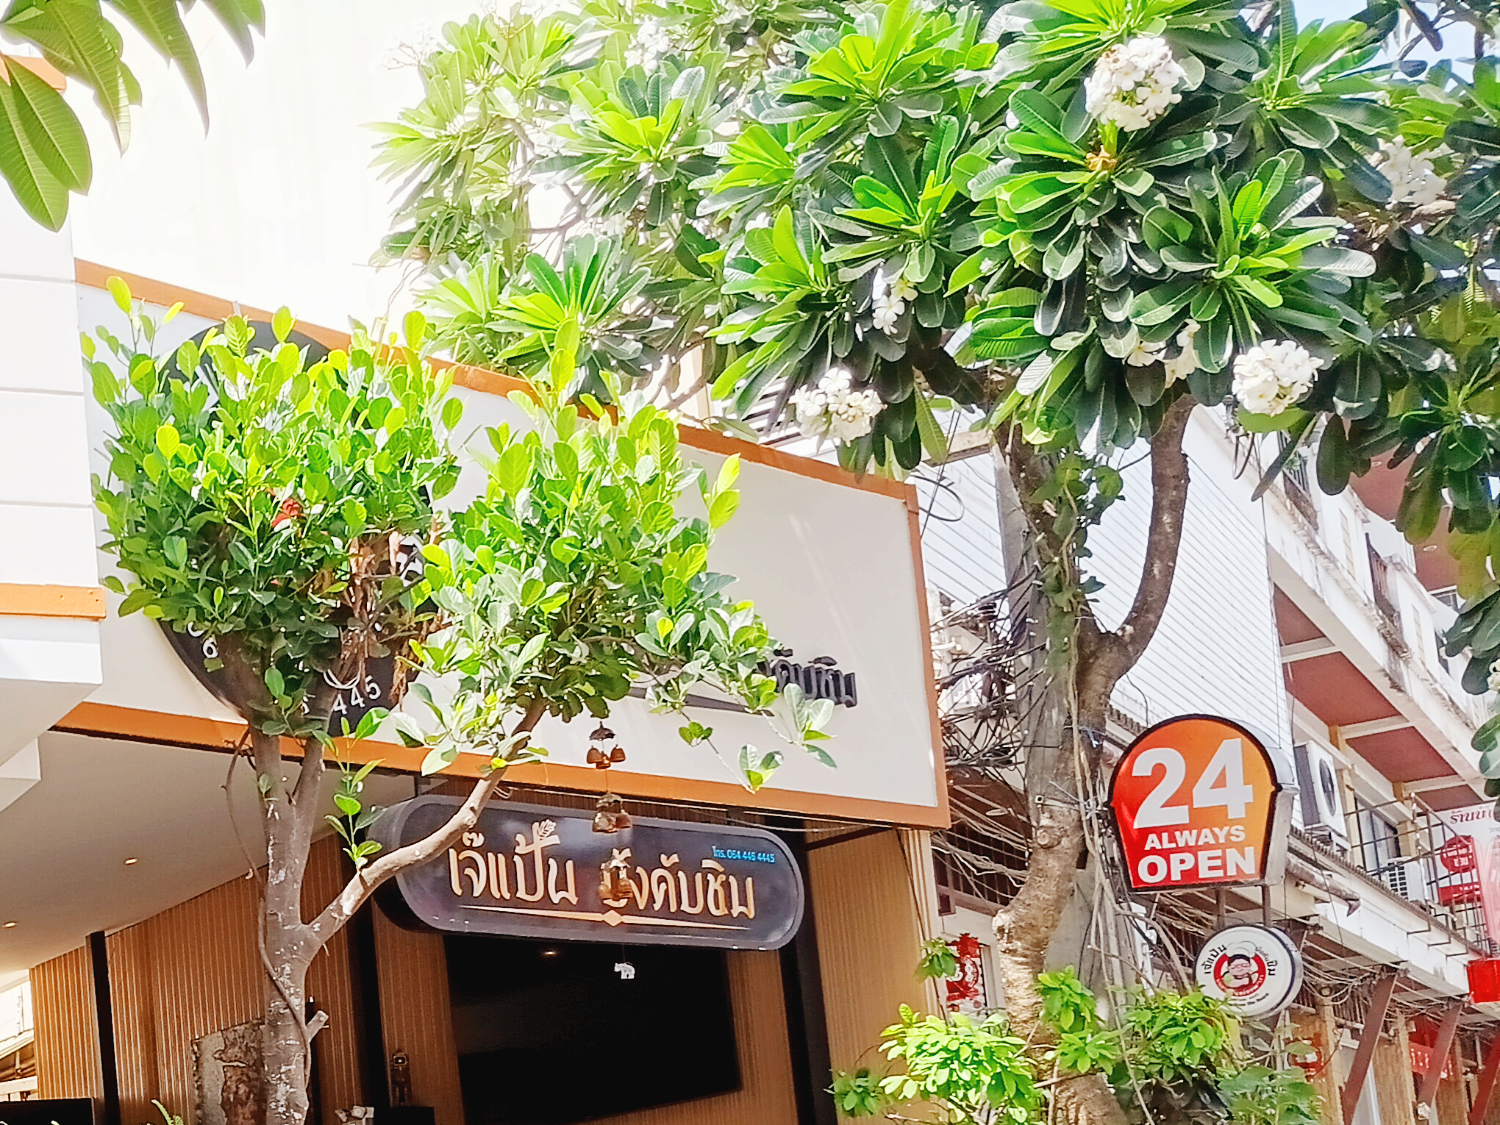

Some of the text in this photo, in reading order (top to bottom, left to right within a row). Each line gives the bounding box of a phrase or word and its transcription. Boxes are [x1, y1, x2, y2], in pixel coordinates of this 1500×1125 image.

[1131, 738, 1254, 829] 24
[1144, 825, 1246, 850] ALWAYS
[1137, 847, 1256, 884] OPEN
